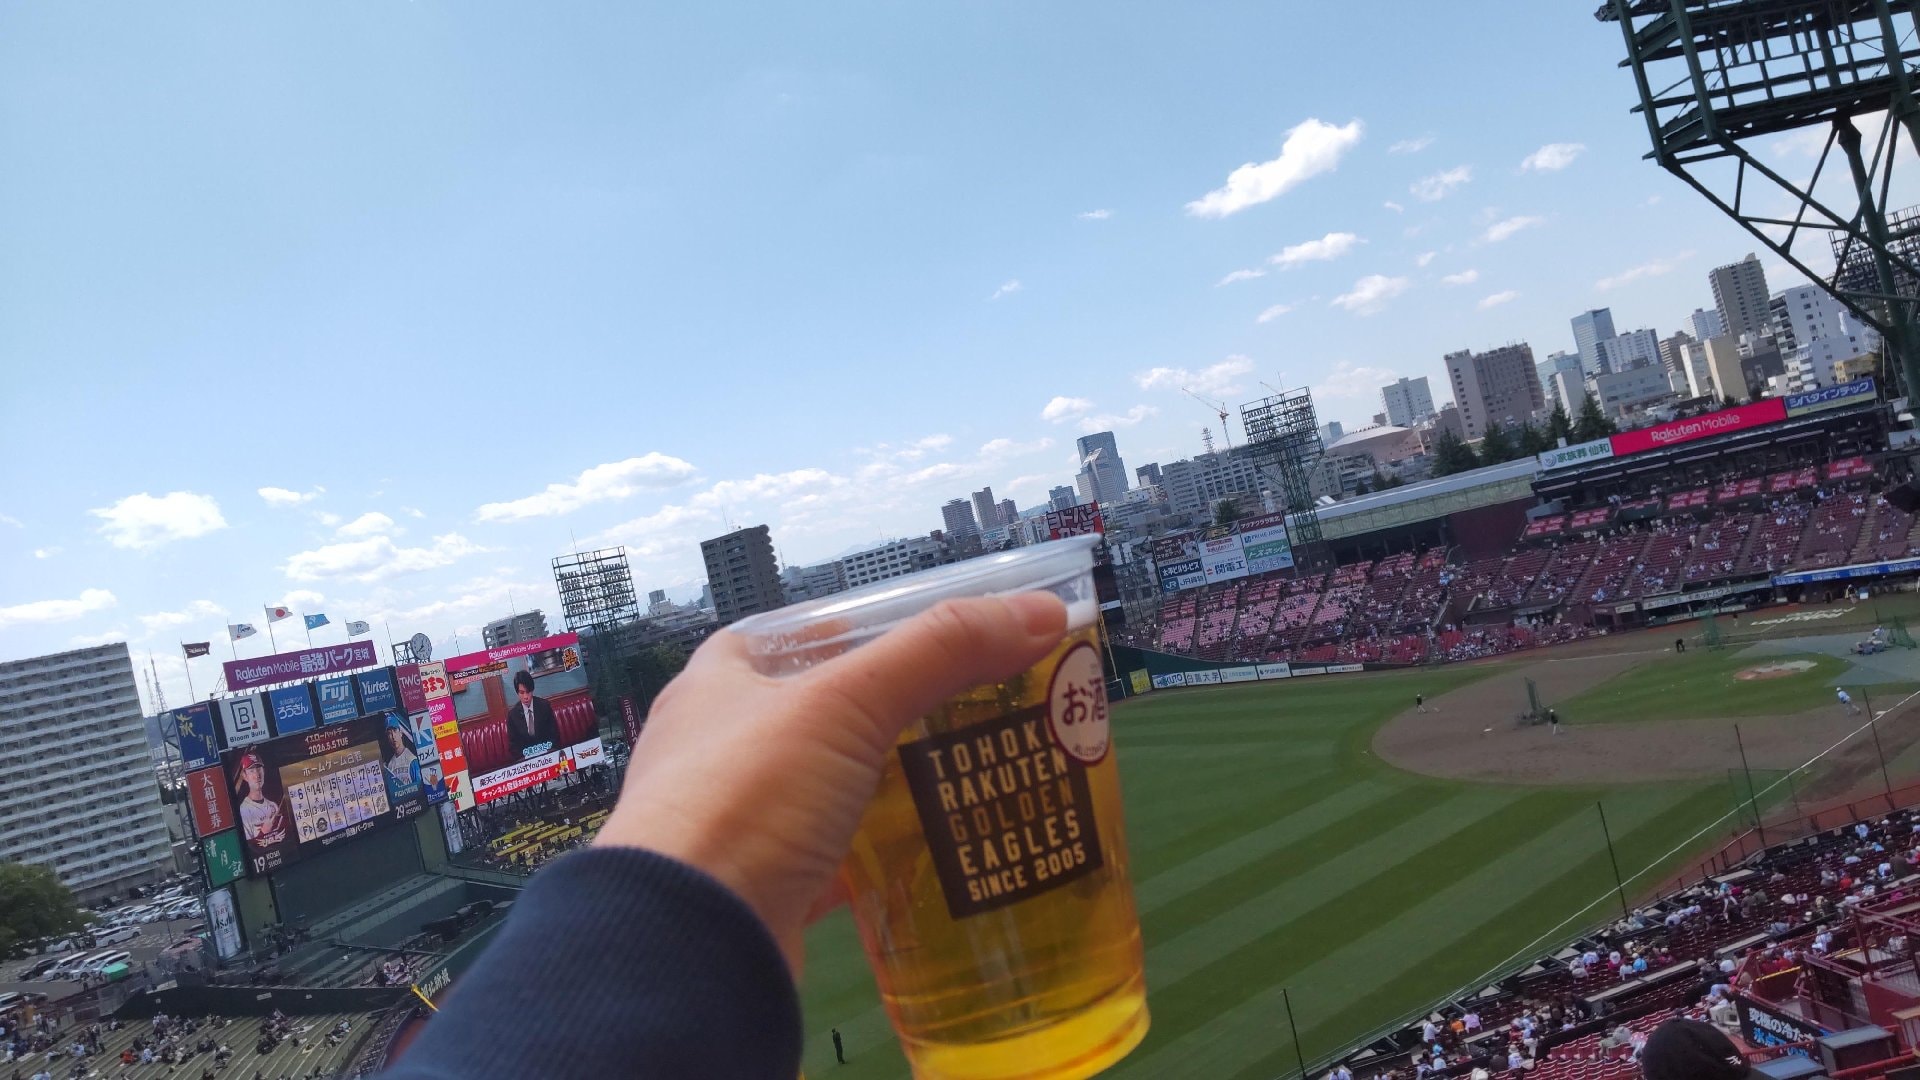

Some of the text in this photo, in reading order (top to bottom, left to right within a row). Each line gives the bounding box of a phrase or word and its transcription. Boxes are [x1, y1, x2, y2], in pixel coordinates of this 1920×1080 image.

[1651, 413, 1741, 444] Rakuten Mobile
[1046, 504, 1100, 530] ヨドバシ
[1214, 559, 1246, 576] 関電工
[235, 665, 274, 683] Rakuten
[273, 661, 300, 675] Mobile
[400, 676, 421, 690] TWG
[321, 680, 349, 705] Fuji
[362, 680, 390, 696] Yurtec
[277, 702, 309, 720] ろうきん
[417, 747, 436, 761] カメイ
[938, 748, 1069, 812] RAKUTEN
[201, 773, 222, 828] 大和証券
[395, 803, 405, 819] 29
[948, 777, 1074, 843] GOLDEN
[958, 808, 1081, 877] EAGLES
[253, 856, 266, 874] 19
[967, 841, 1087, 902] SINCE 2005
